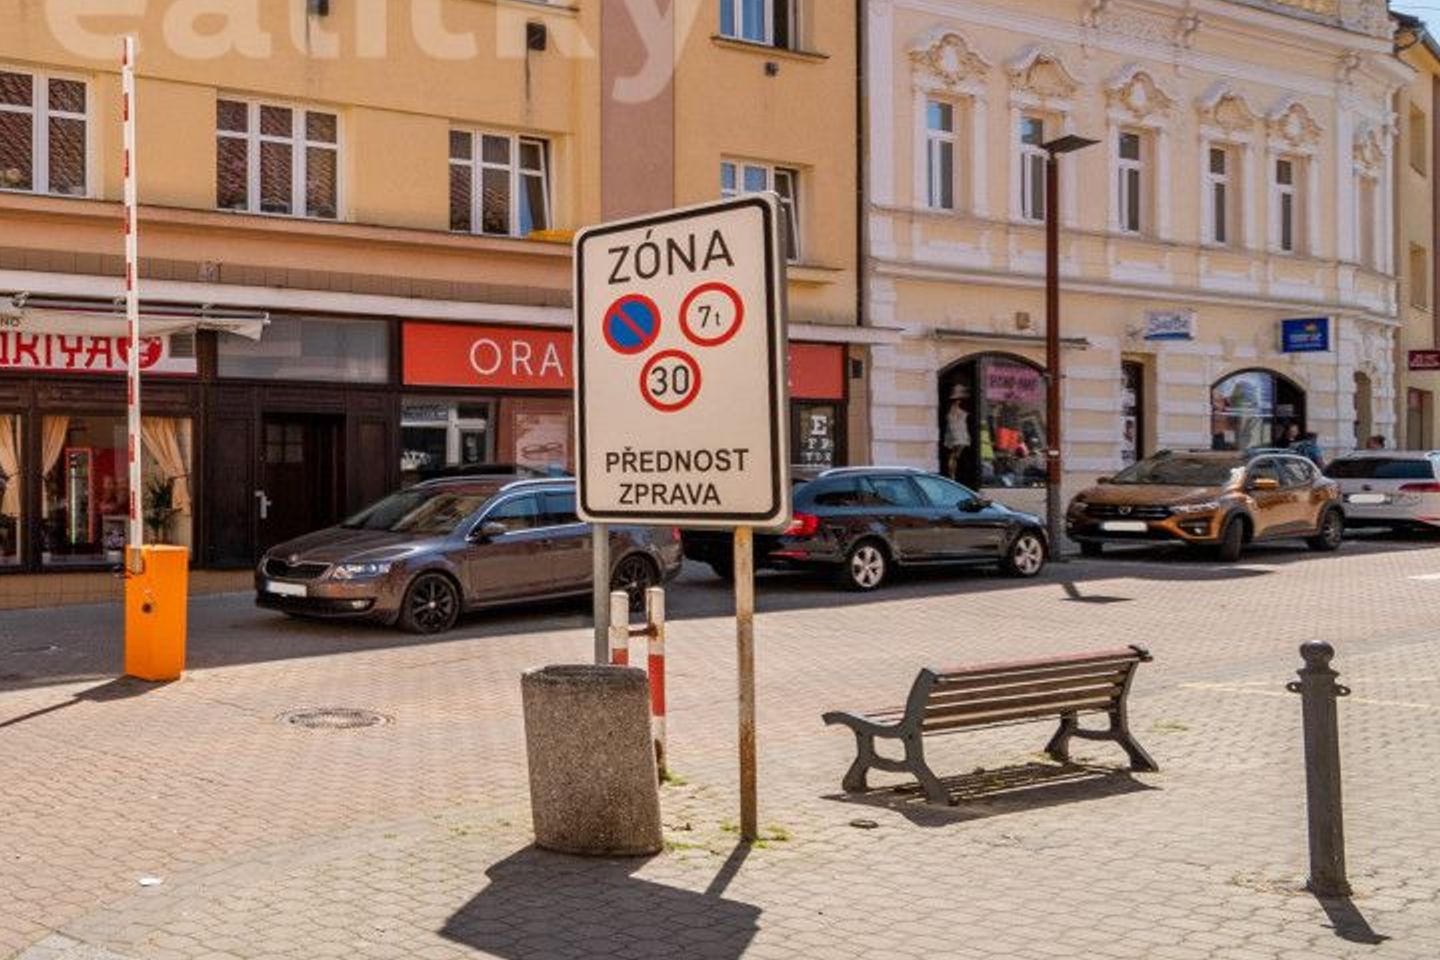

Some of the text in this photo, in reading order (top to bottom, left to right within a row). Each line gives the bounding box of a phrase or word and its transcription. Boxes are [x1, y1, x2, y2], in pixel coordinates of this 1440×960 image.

[607, 229, 735, 285] ZÓNA
[651, 365, 690, 396] 30
[605, 446, 750, 474] PŘEDNOST
[618, 483, 722, 507] ZPRAVA
